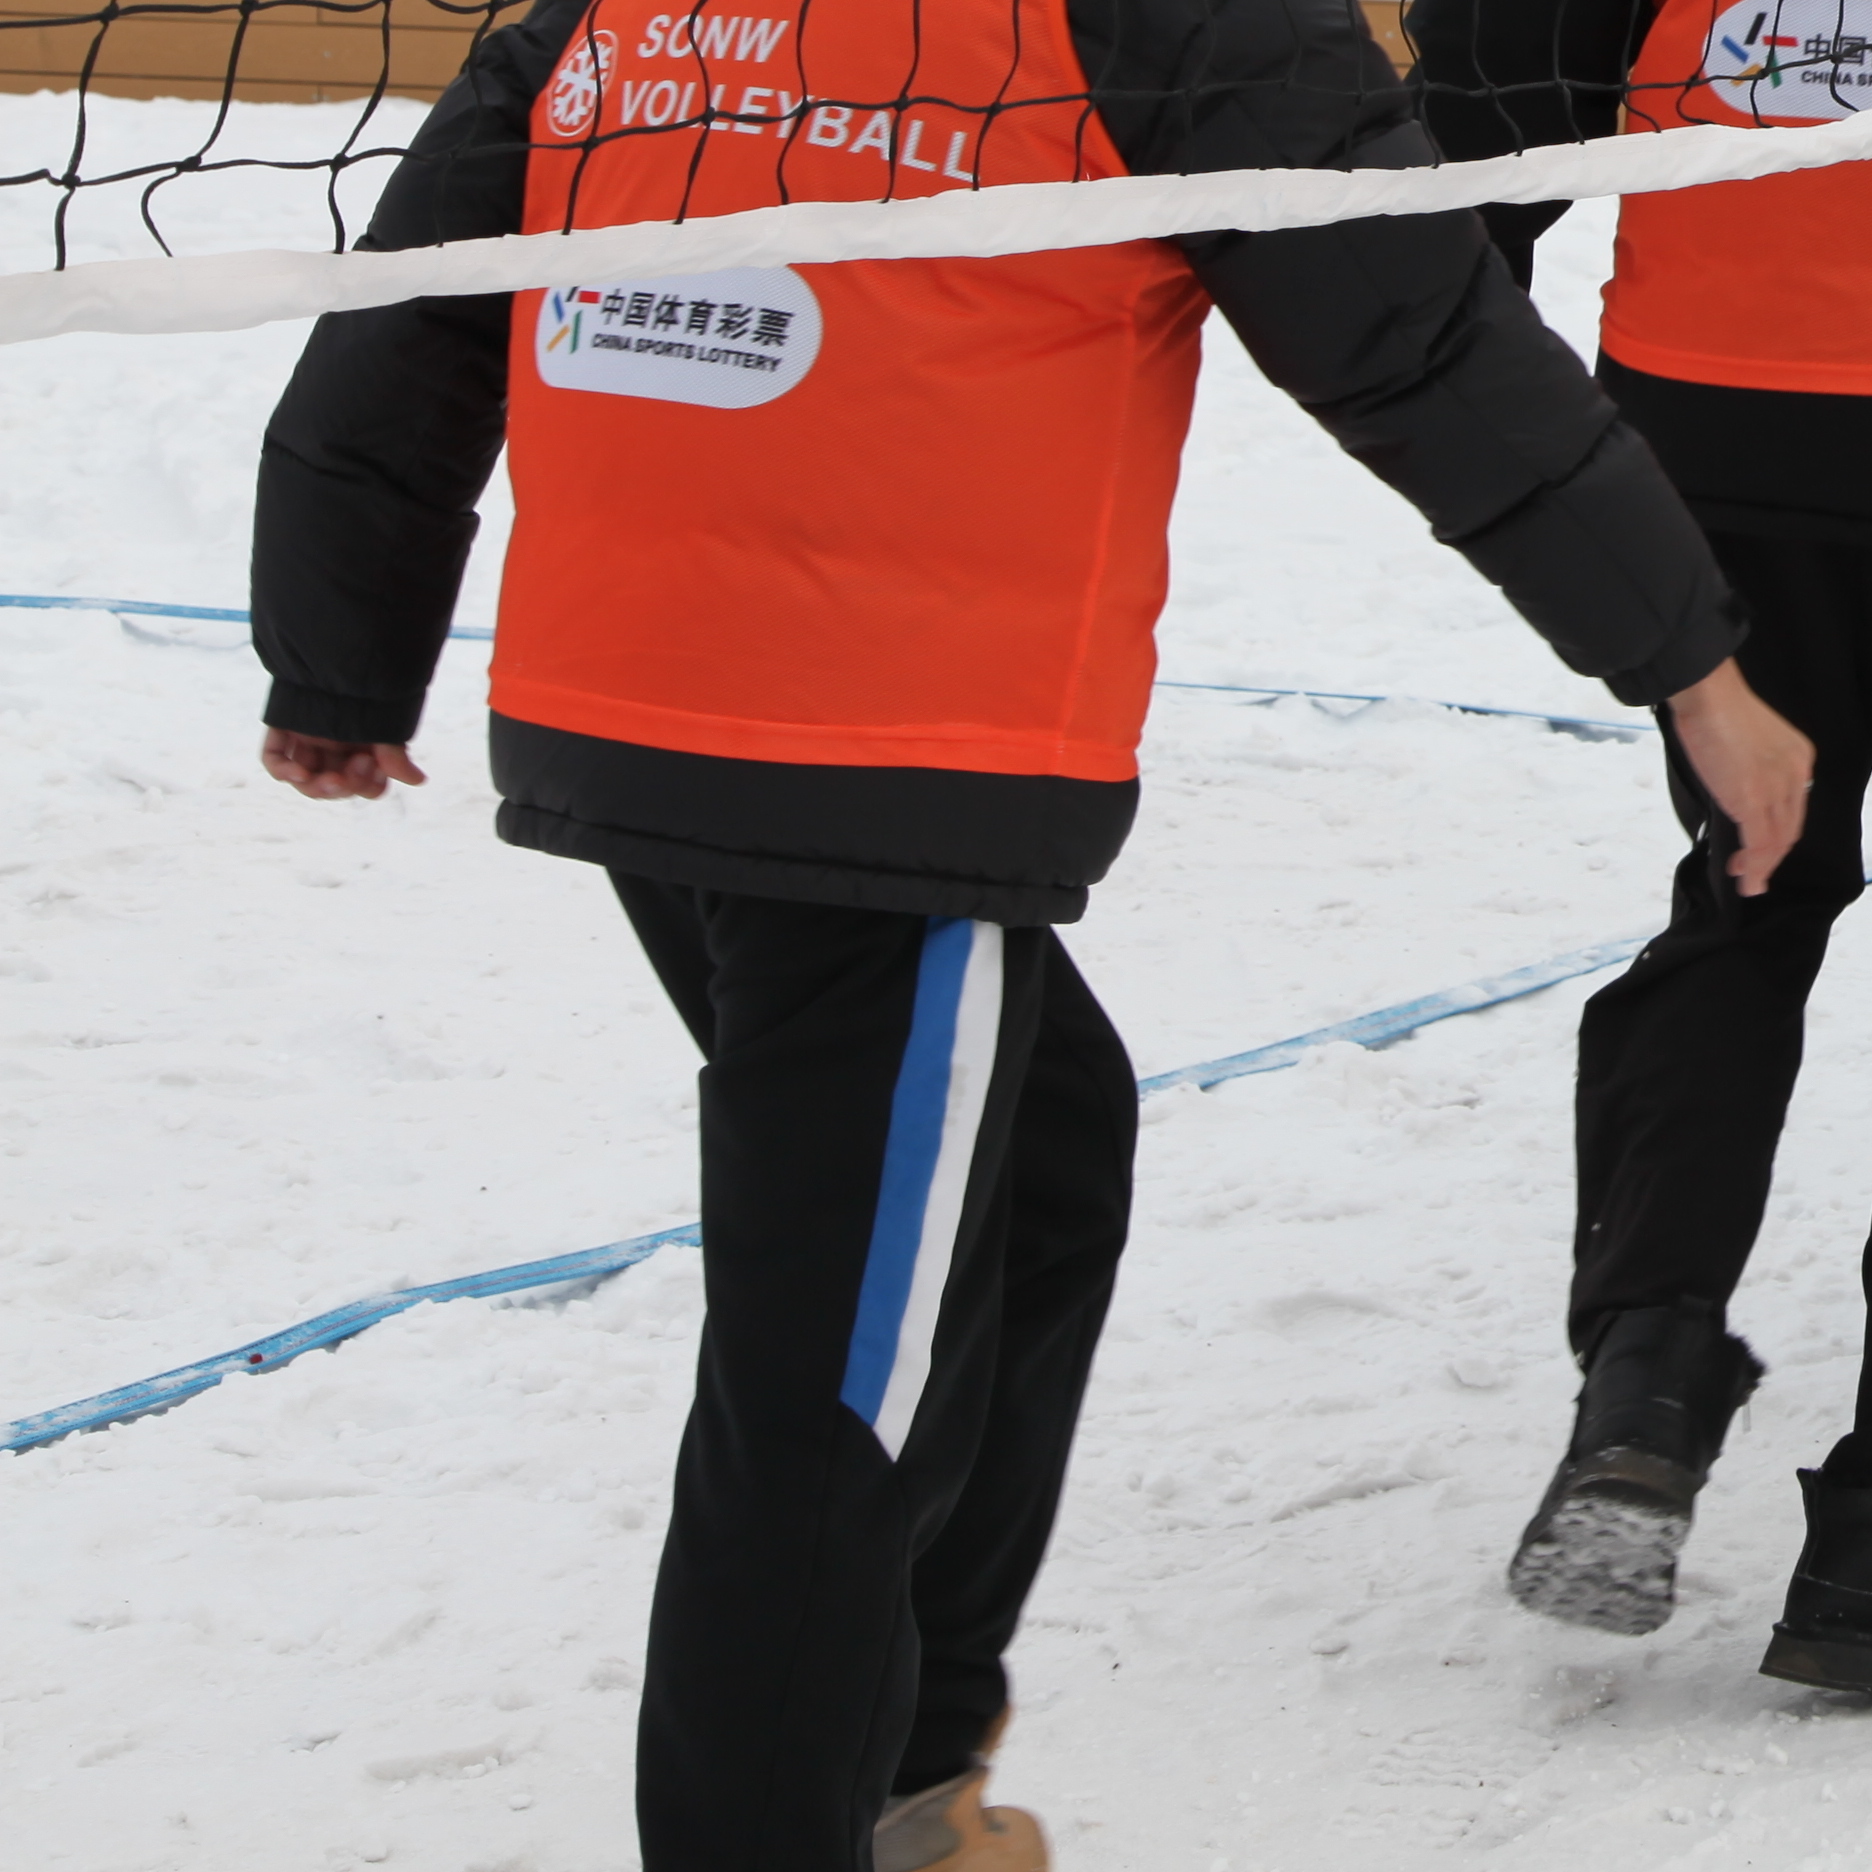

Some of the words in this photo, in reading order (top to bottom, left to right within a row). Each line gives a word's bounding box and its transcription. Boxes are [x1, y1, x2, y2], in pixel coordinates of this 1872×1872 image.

[637, 14, 789, 63] SONW
[1802, 70, 1853, 85] CHINA
[620, 79, 980, 183] VOLLEYBALL
[601, 289, 795, 347] 中国体育彩票
[634, 338, 695, 359] SPORTS
[698, 346, 782, 372] LOTTERY
